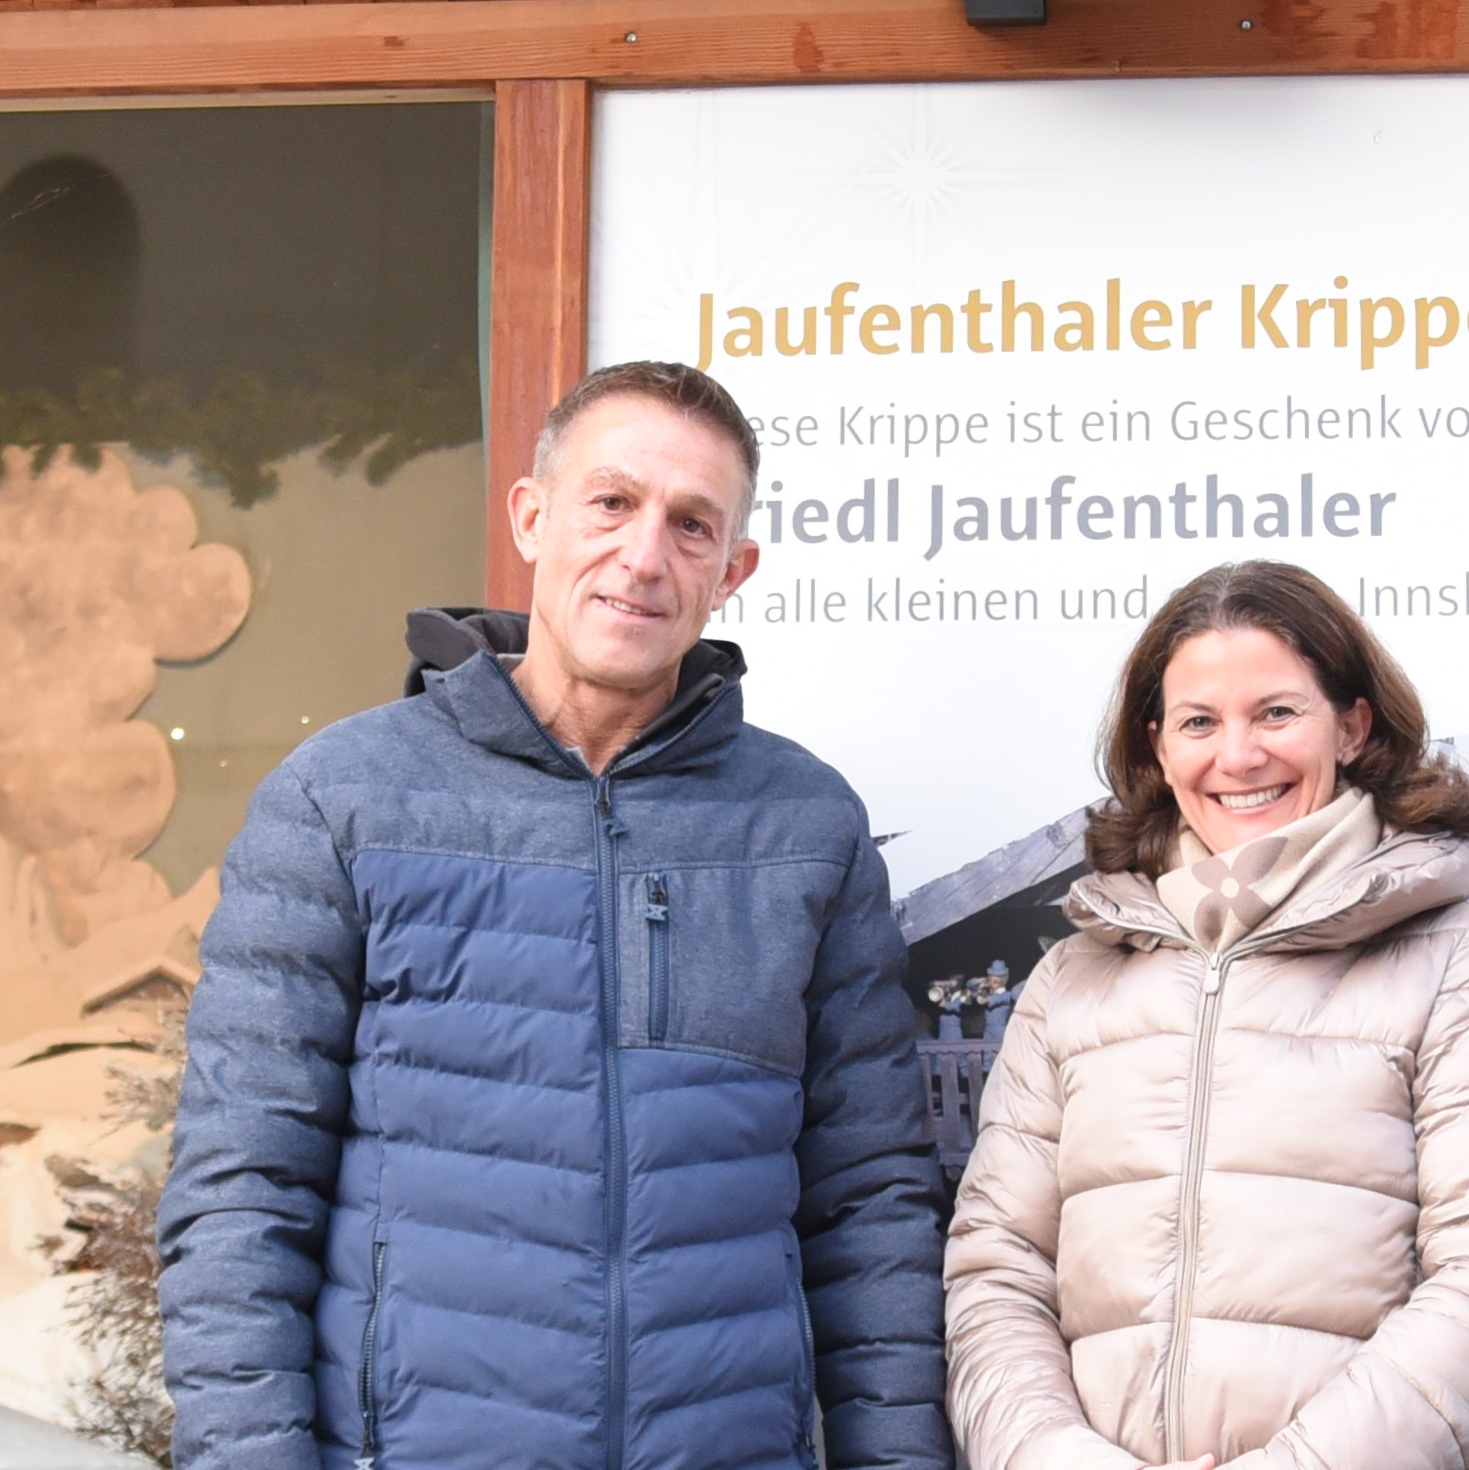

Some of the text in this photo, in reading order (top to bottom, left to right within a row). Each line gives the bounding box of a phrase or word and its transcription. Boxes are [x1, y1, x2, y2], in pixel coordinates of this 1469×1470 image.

[695, 279, 1212, 373] Jaufenthaler
[747, 415, 819, 447] ese
[839, 402, 989, 458] Krippe
[1007, 400, 1063, 443] ist
[1081, 399, 1151, 442] ein
[1170, 394, 1402, 442] Geschenk
[923, 471, 1398, 563] Jaufenthaler
[707, 592, 744, 624] n
[764, 577, 847, 624] alle
[867, 577, 1039, 622] kleinen
[1060, 574, 1148, 621] und
